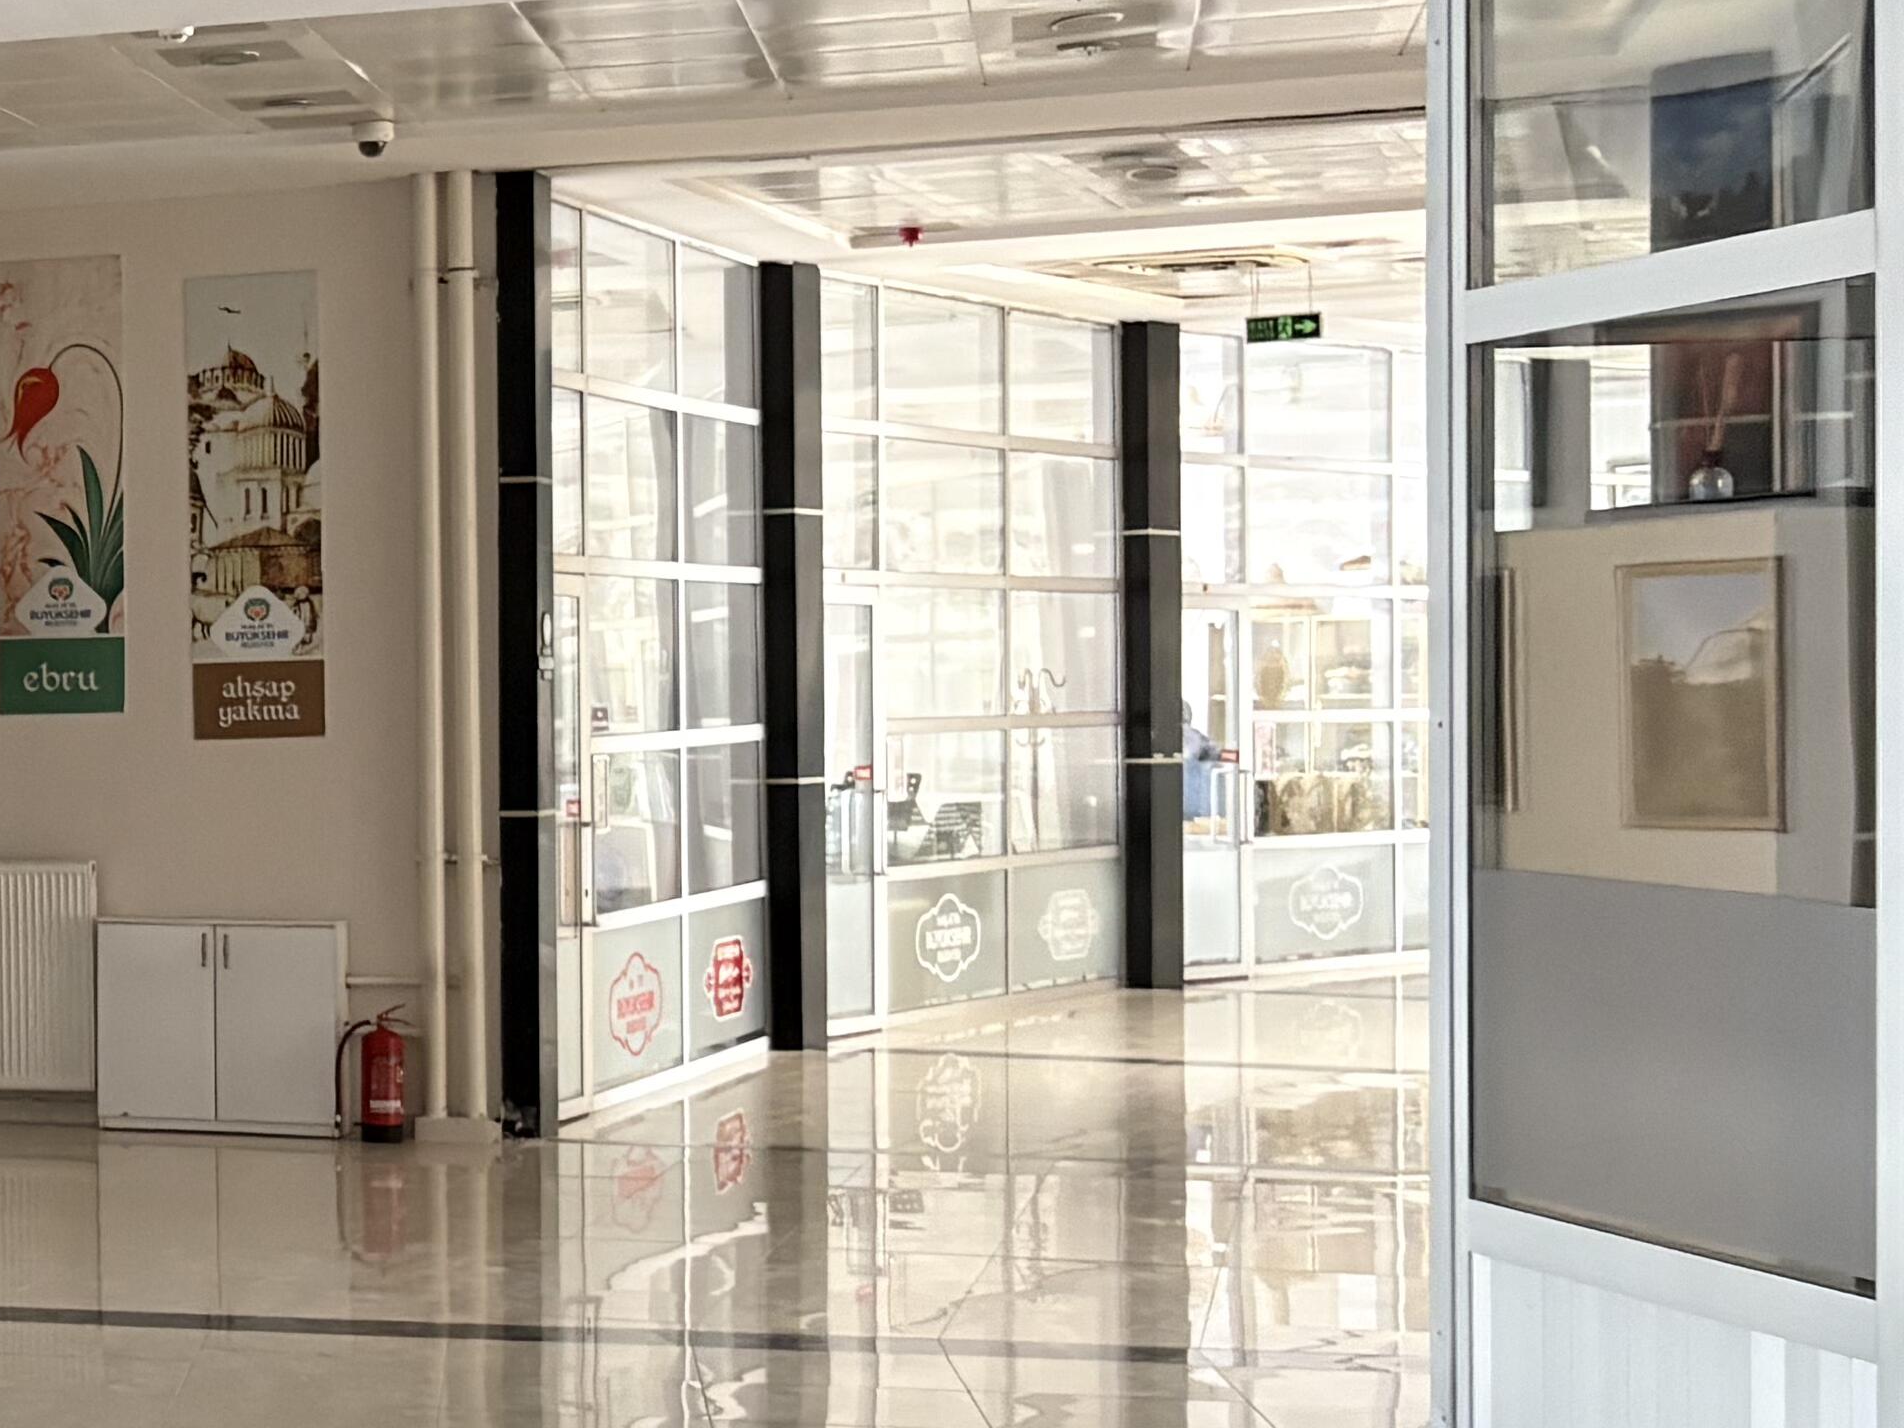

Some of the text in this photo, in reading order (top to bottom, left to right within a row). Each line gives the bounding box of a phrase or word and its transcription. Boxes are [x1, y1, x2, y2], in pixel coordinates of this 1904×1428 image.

[23, 661, 99, 692] ebru
[222, 675, 296, 703] ahşap
[218, 699, 301, 728] yakma
